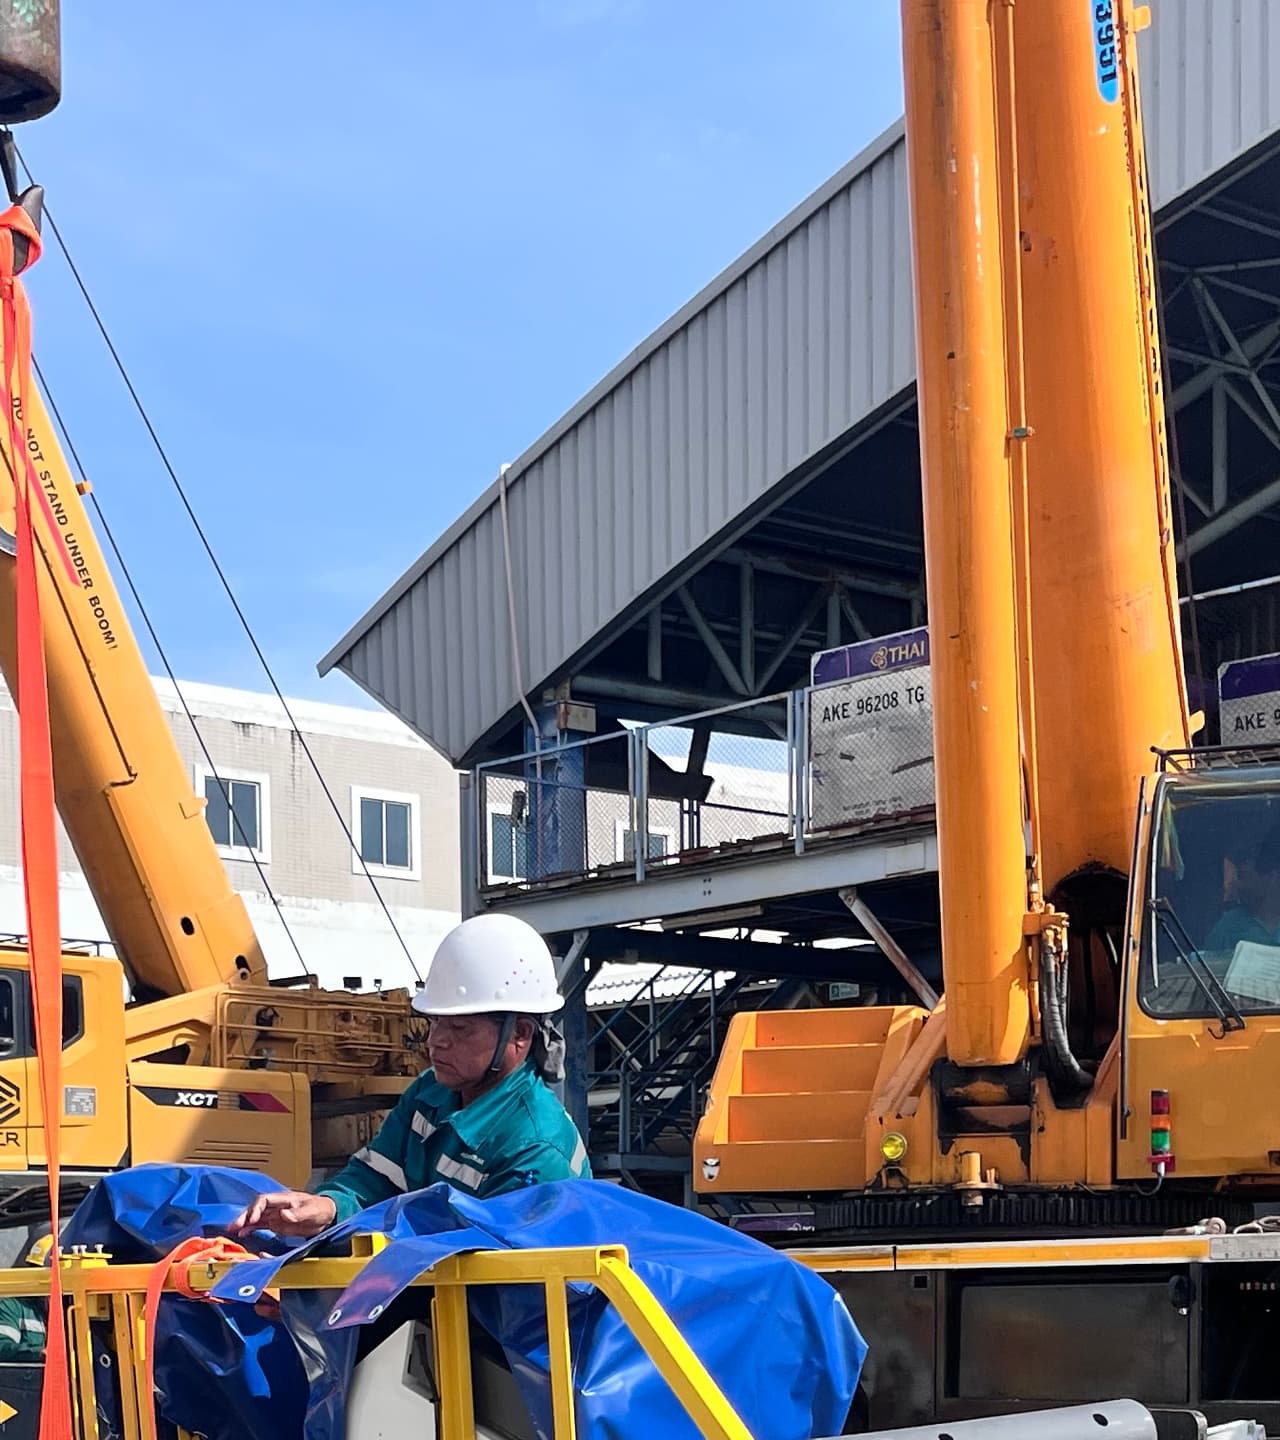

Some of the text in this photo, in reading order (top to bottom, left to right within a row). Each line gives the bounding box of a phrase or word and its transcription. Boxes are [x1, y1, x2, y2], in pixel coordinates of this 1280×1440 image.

[26, 428, 45, 462] NOT
[39, 470, 69, 526] STAND
[64, 532, 94, 590] UNDER
[88, 595, 118, 650] BOOM!
[889, 640, 925, 663] THAI
[823, 686, 925, 723] AKE 96208 TG
[1234, 712, 1266, 732] AKE
[174, 1091, 218, 1106] XCT
